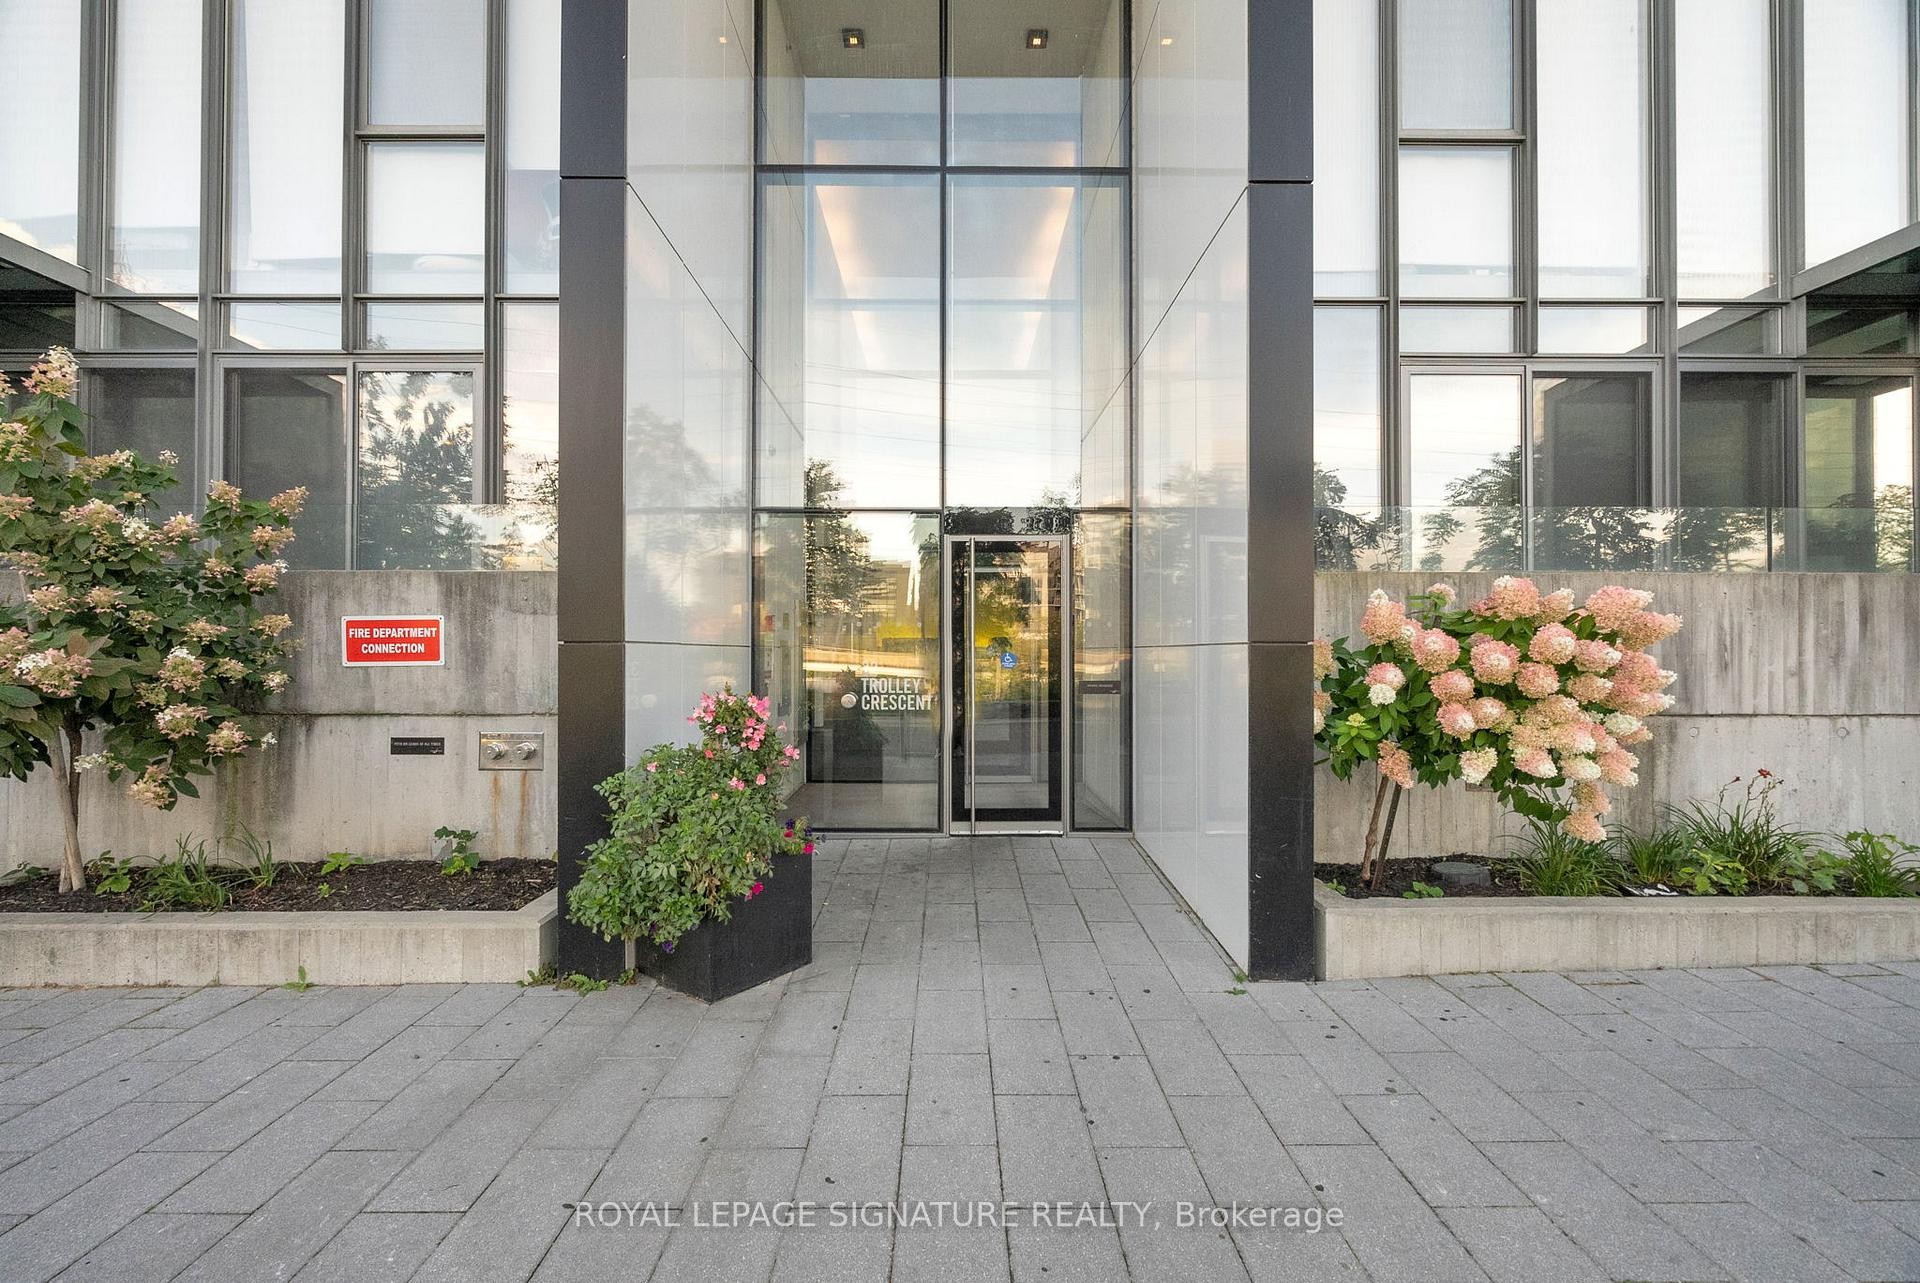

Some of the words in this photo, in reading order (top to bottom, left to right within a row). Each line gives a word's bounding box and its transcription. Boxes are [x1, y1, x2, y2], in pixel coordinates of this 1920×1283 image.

[349, 627, 371, 638] FIRE
[373, 627, 437, 638] DEPARTMENT
[361, 643, 425, 654] CONNECTION
[860, 677, 921, 694] TROLLEY
[861, 694, 932, 711] CRESCENT
